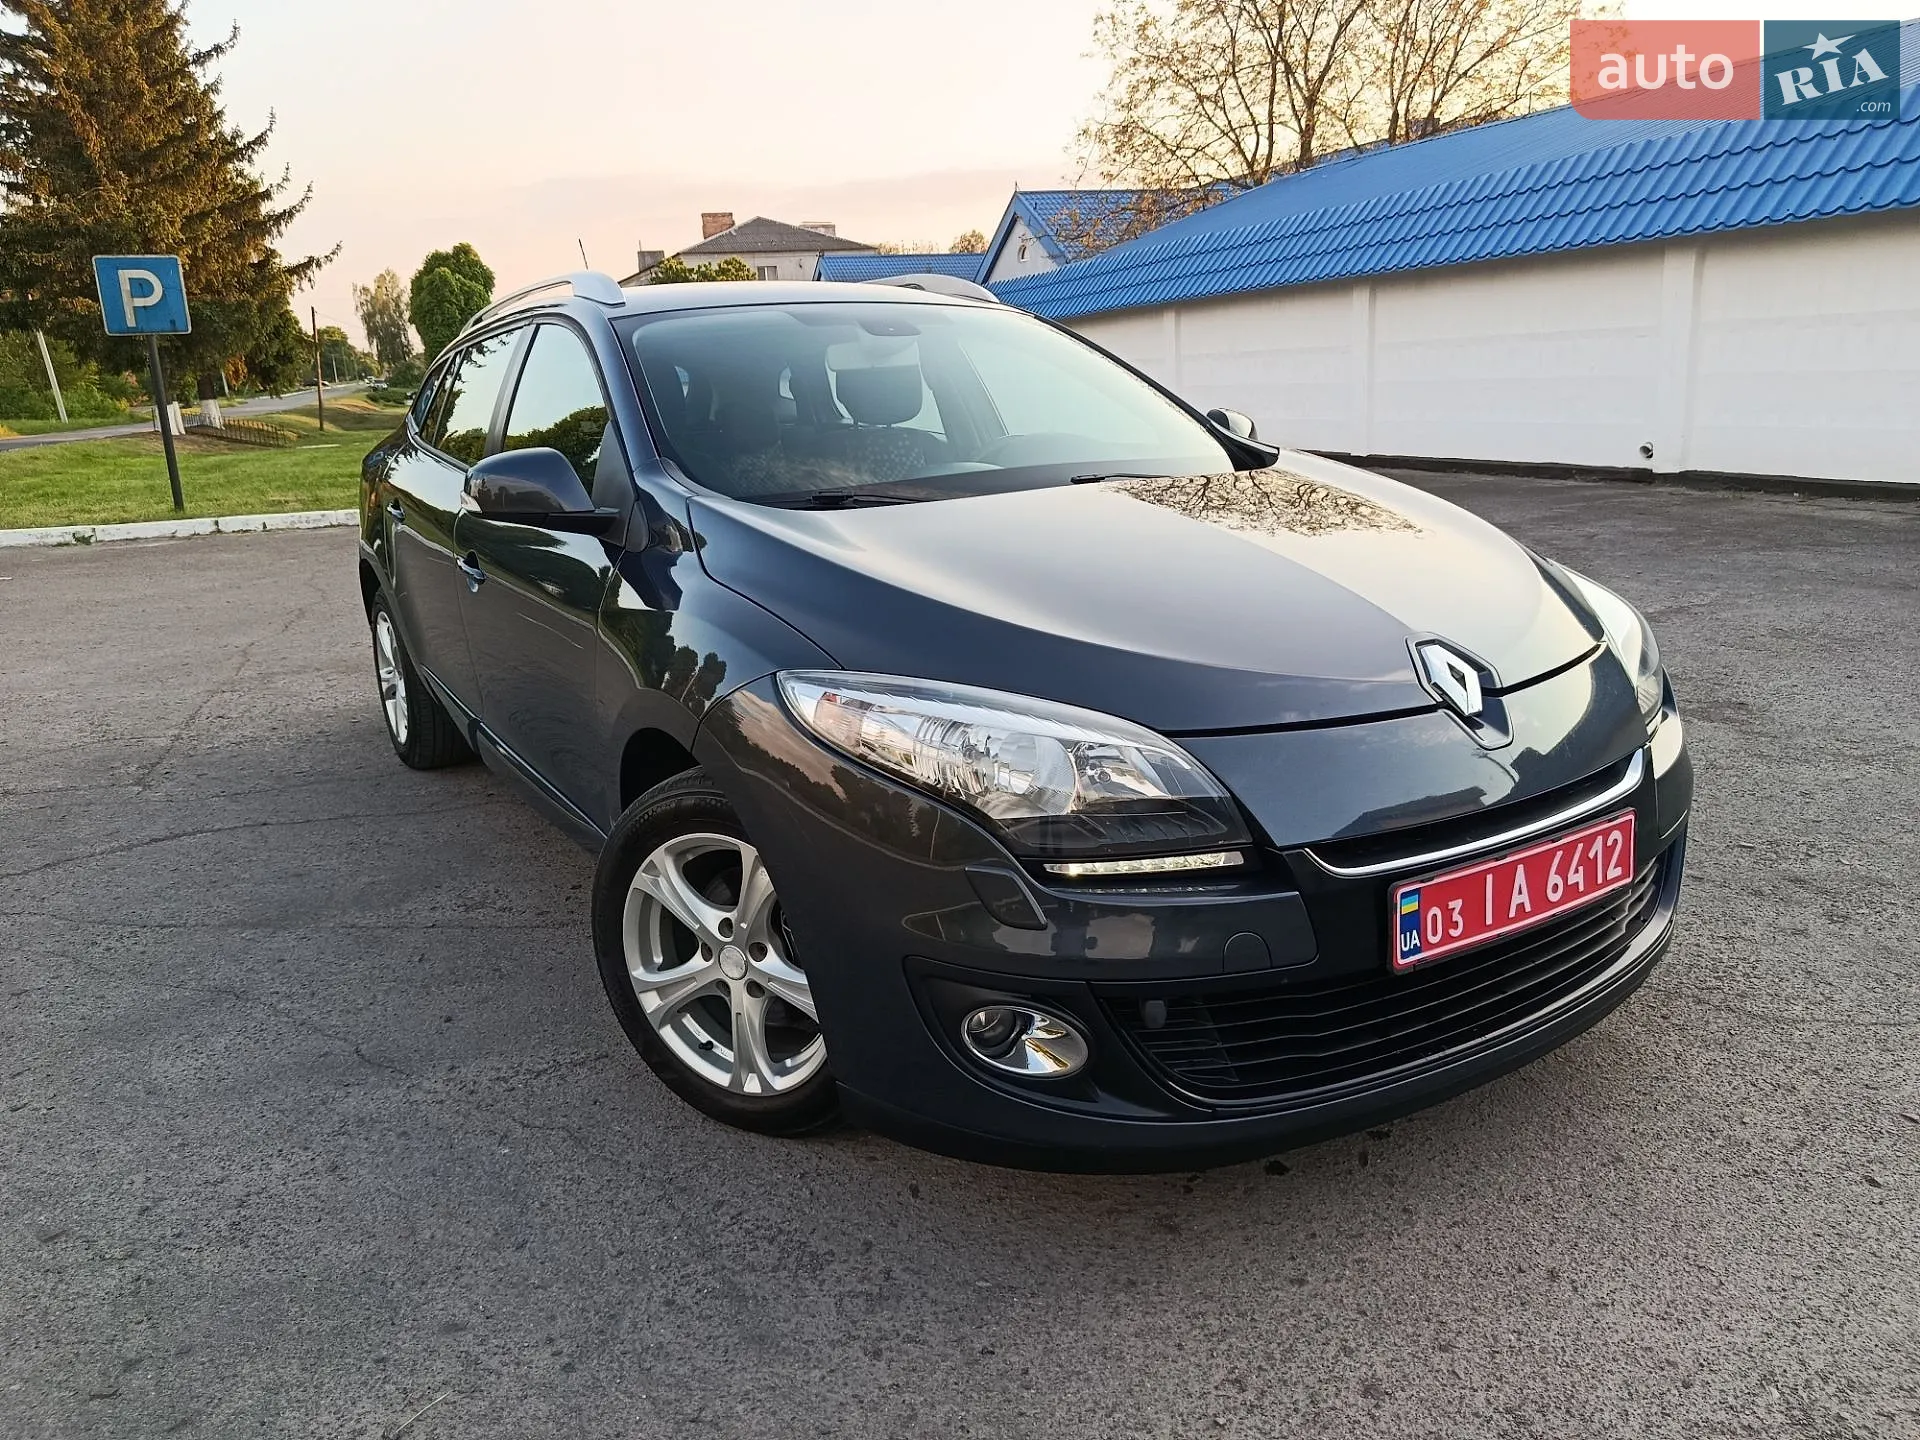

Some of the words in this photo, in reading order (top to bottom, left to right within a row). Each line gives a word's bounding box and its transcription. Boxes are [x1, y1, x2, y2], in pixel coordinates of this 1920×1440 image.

[118, 269, 163, 327] P
[1426, 898, 1464, 944] 03
[1485, 863, 1532, 926] IA
[1546, 829, 1624, 903] 6412
[1400, 930, 1421, 952] UA
